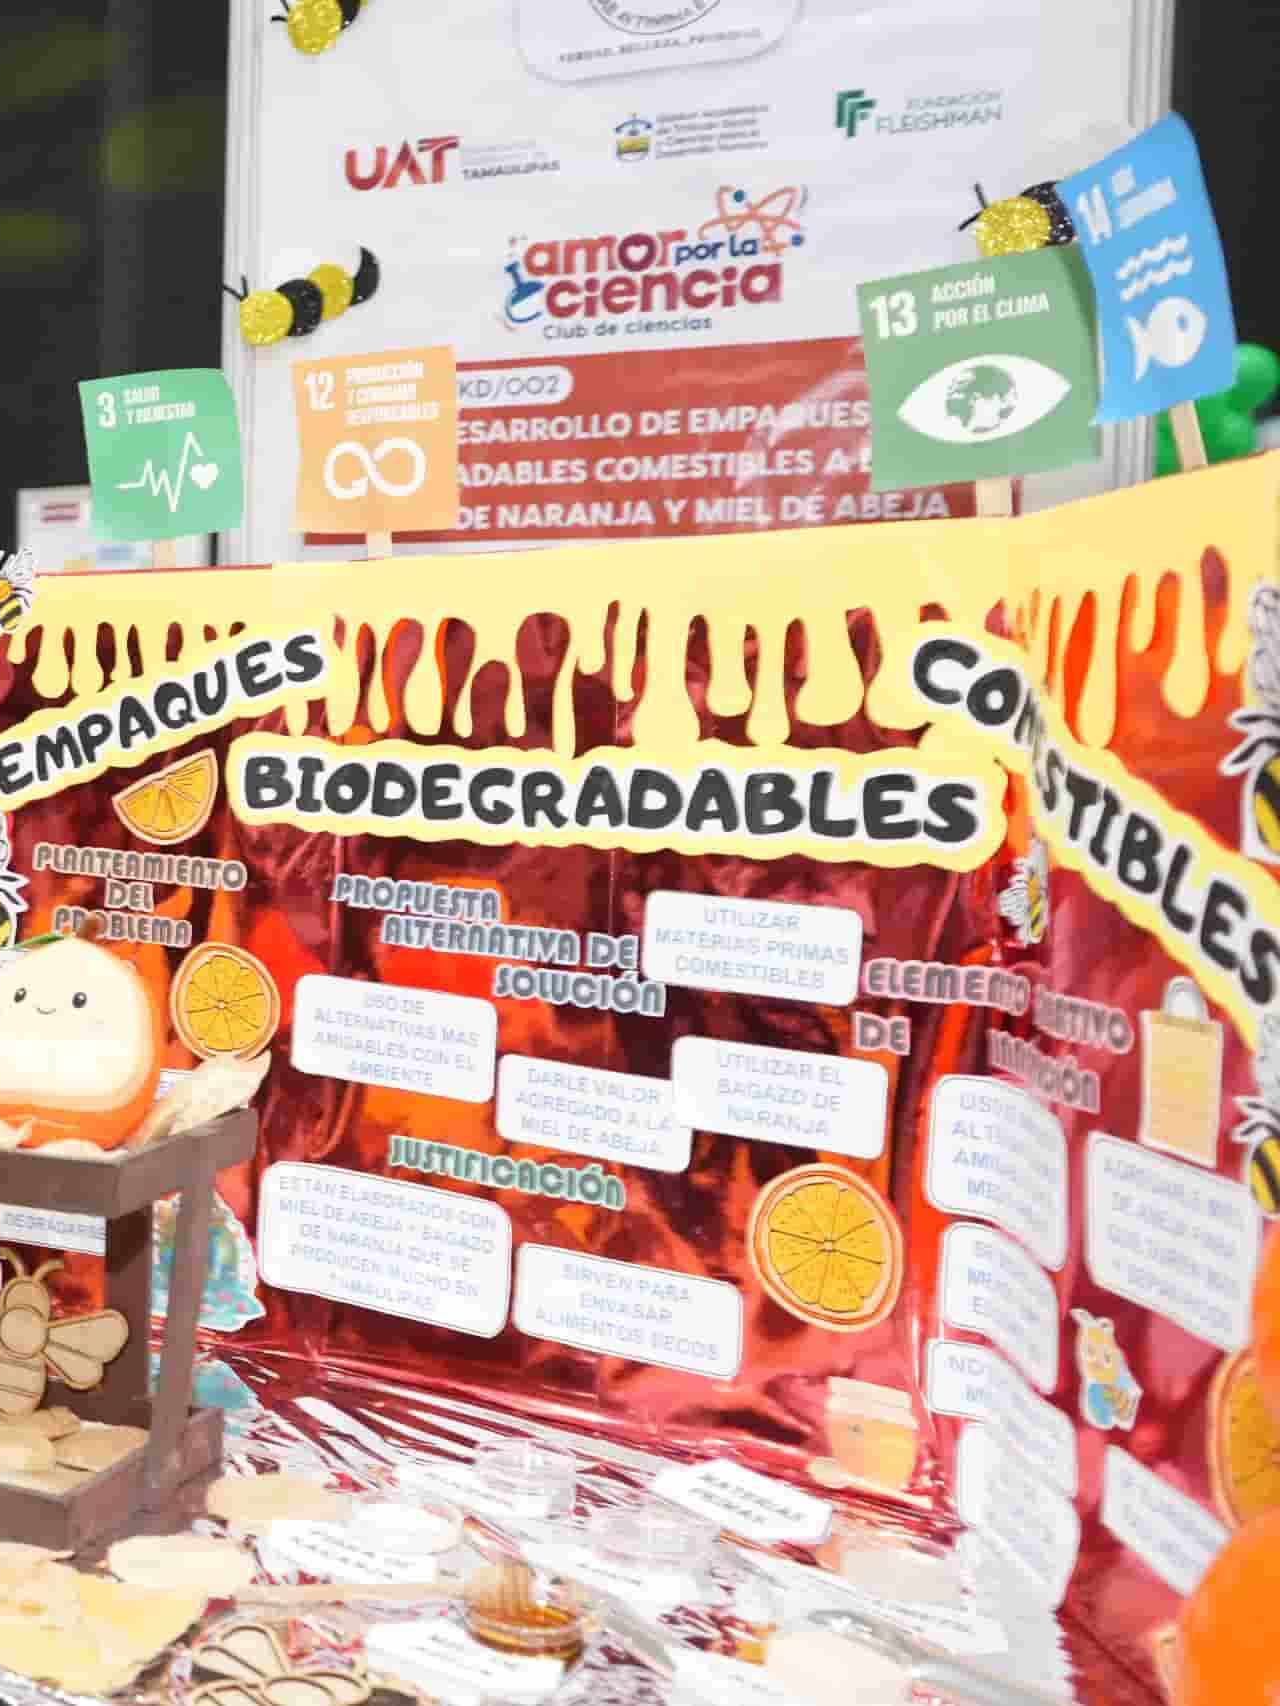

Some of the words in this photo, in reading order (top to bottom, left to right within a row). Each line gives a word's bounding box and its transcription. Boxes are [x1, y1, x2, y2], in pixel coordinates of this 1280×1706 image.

[876, 106, 1002, 134] FLEISHMAN
[345, 136, 460, 191] UAT
[460, 160, 561, 181] TAMAULIPAS
[524, 230, 687, 277] amor
[674, 242, 725, 266] por
[729, 234, 759, 257] la
[545, 263, 783, 318] ciencia
[930, 272, 996, 303] ACCIÓN
[543, 324, 588, 341] Club
[593, 320, 618, 337] de
[624, 317, 713, 336] ciencias
[869, 289, 919, 340] 13
[933, 306, 970, 331] POR
[972, 302, 994, 325] EL
[994, 292, 1049, 322] CLIMA
[97, 391, 117, 429] 3
[304, 370, 336, 411] 12
[456, 411, 633, 446] ESARROLLO
[639, 409, 681, 436] DE
[456, 457, 588, 489] ADABLES
[594, 449, 814, 484] COMESTIBLES
[497, 500, 653, 529] NARANJA
[663, 498, 688, 525] Y
[695, 495, 771, 525] MIEL
[780, 494, 823, 521] DE
[832, 491, 951, 521] ABEJA
[244, 755, 978, 844] BIODEGRADABLES
[913, 638, 1280, 1006] COMSTIBLES
[35, 843, 247, 890] PLANTEAMIENTO
[107, 881, 154, 911] DEL
[332, 874, 499, 920] PROPUESTA
[704, 905, 801, 930] UTILIZAR
[381, 915, 580, 966] ALTERNATIVA
[587, 933, 638, 968] DE
[767, 940, 849, 965] PRIMAS
[675, 954, 826, 989] COMESTIBLES
[494, 966, 665, 1017] SOLUCIÓN
[855, 1015, 910, 1053] DE
[390, 1135, 625, 1211] JUSTIFICACIÓN
